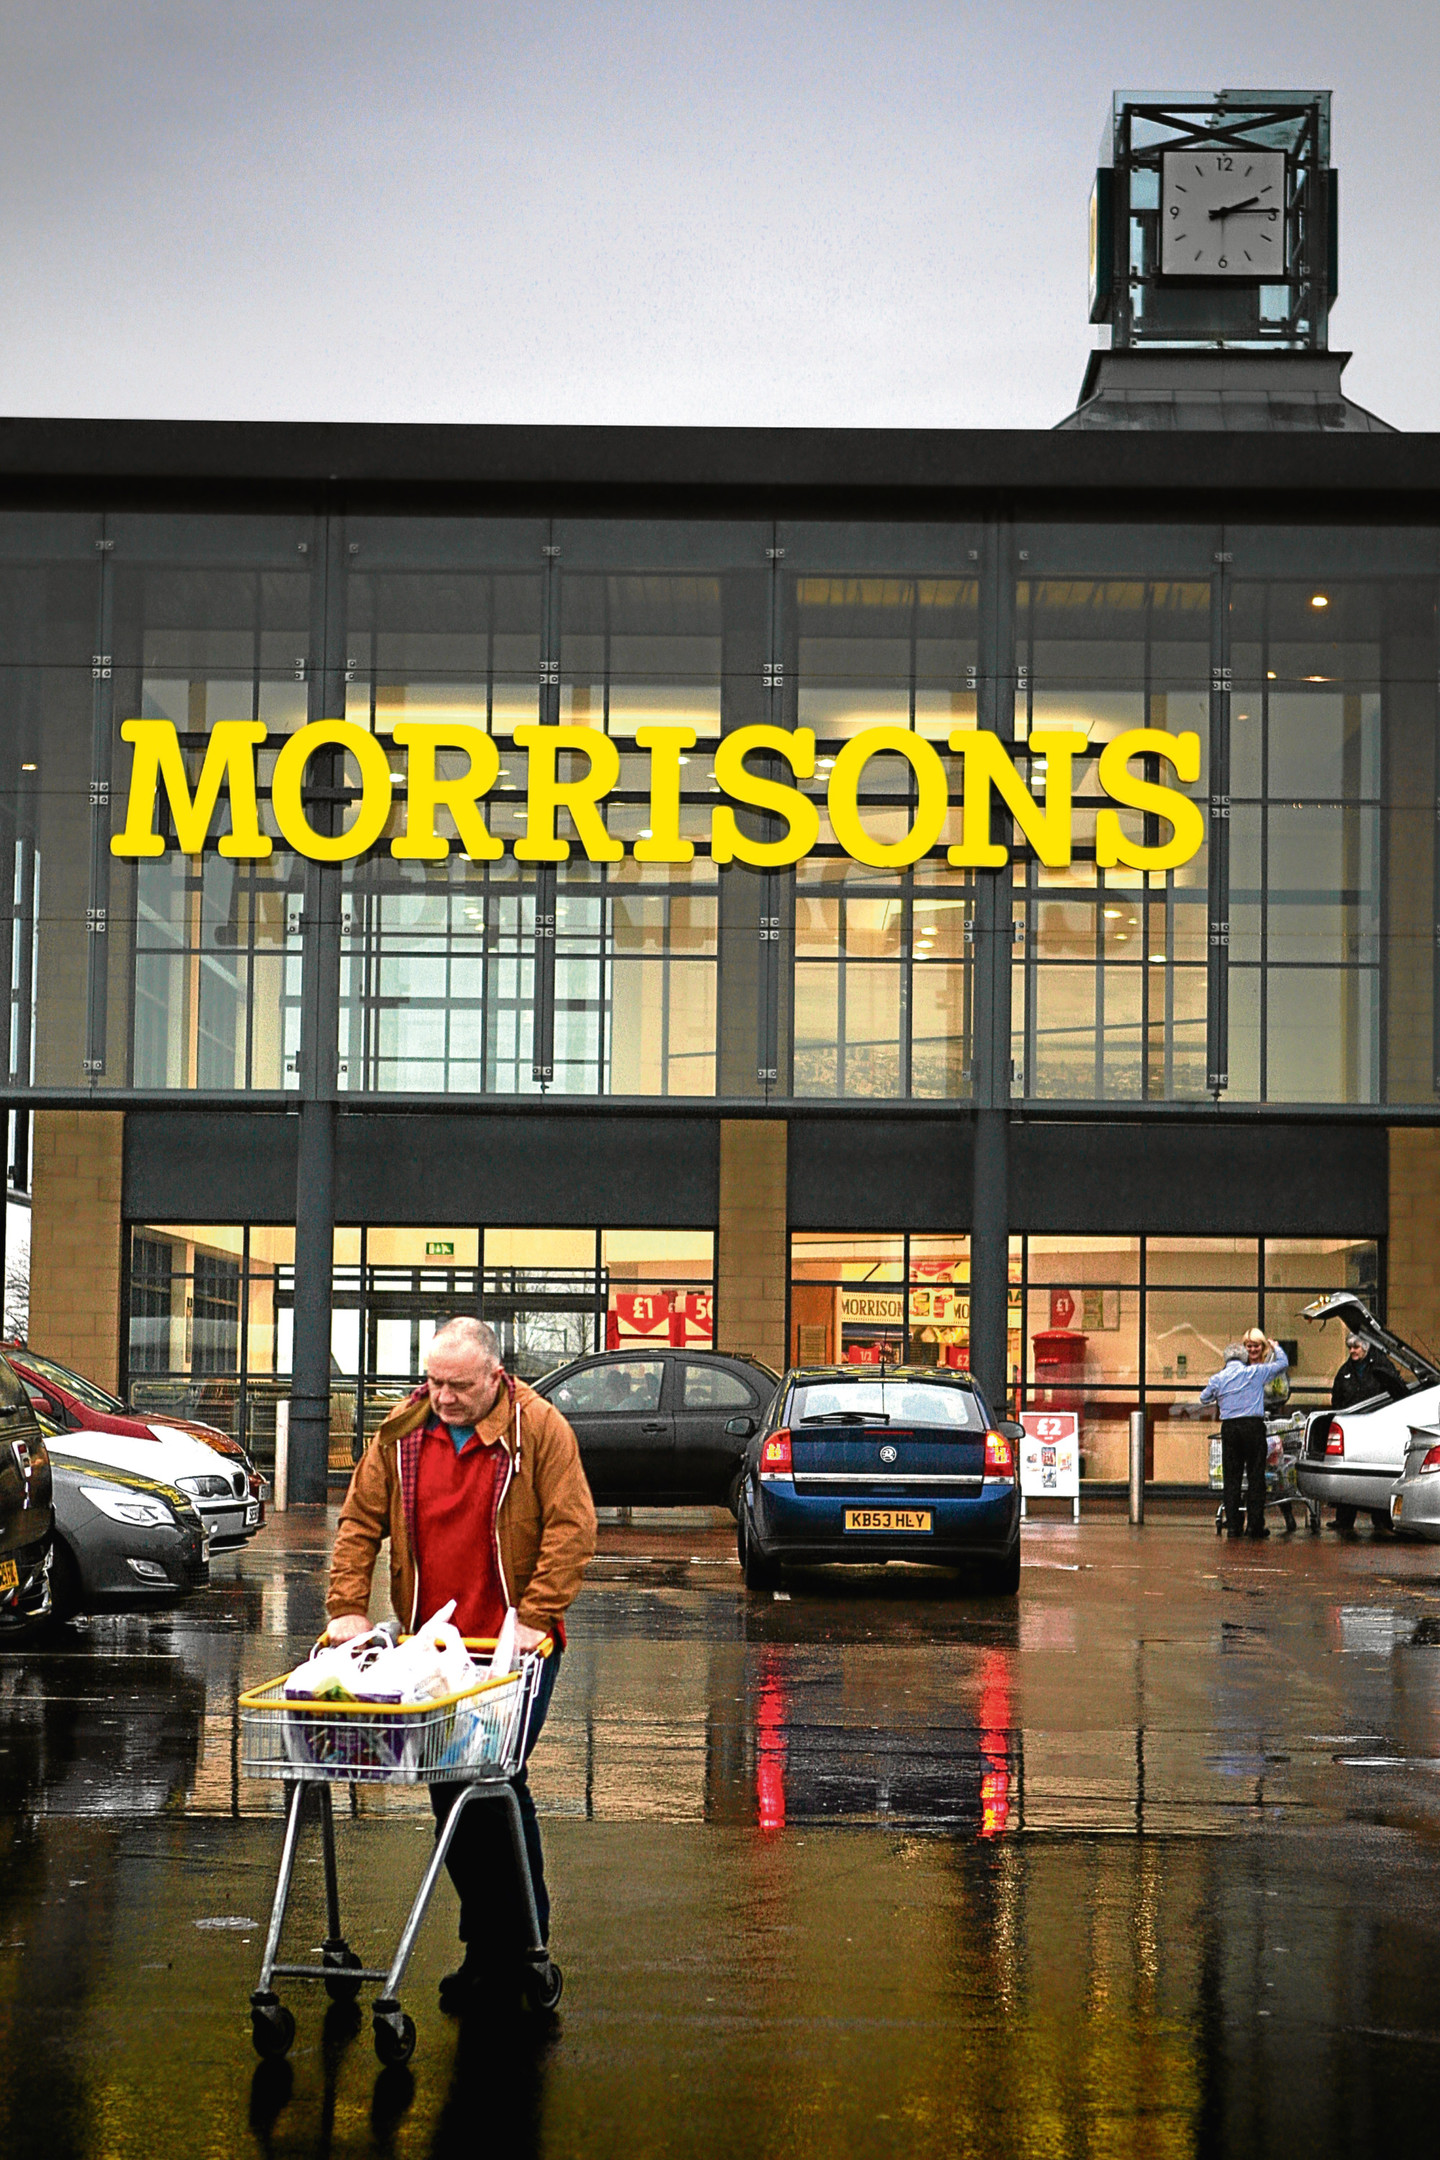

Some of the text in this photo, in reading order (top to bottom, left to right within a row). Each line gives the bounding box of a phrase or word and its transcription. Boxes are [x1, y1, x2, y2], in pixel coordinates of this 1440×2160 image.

[1216, 157, 1233, 171] 12
[1170, 206, 1179, 220] 9
[1218, 255, 1228, 269] 6
[110, 719, 1204, 870] MORRISONS
[632, 1297, 654, 1319] £1
[1055, 1298, 1069, 1312] £1
[1036, 1418, 1062, 1435] £2
[852, 1513, 925, 1528] KB53 HLY
